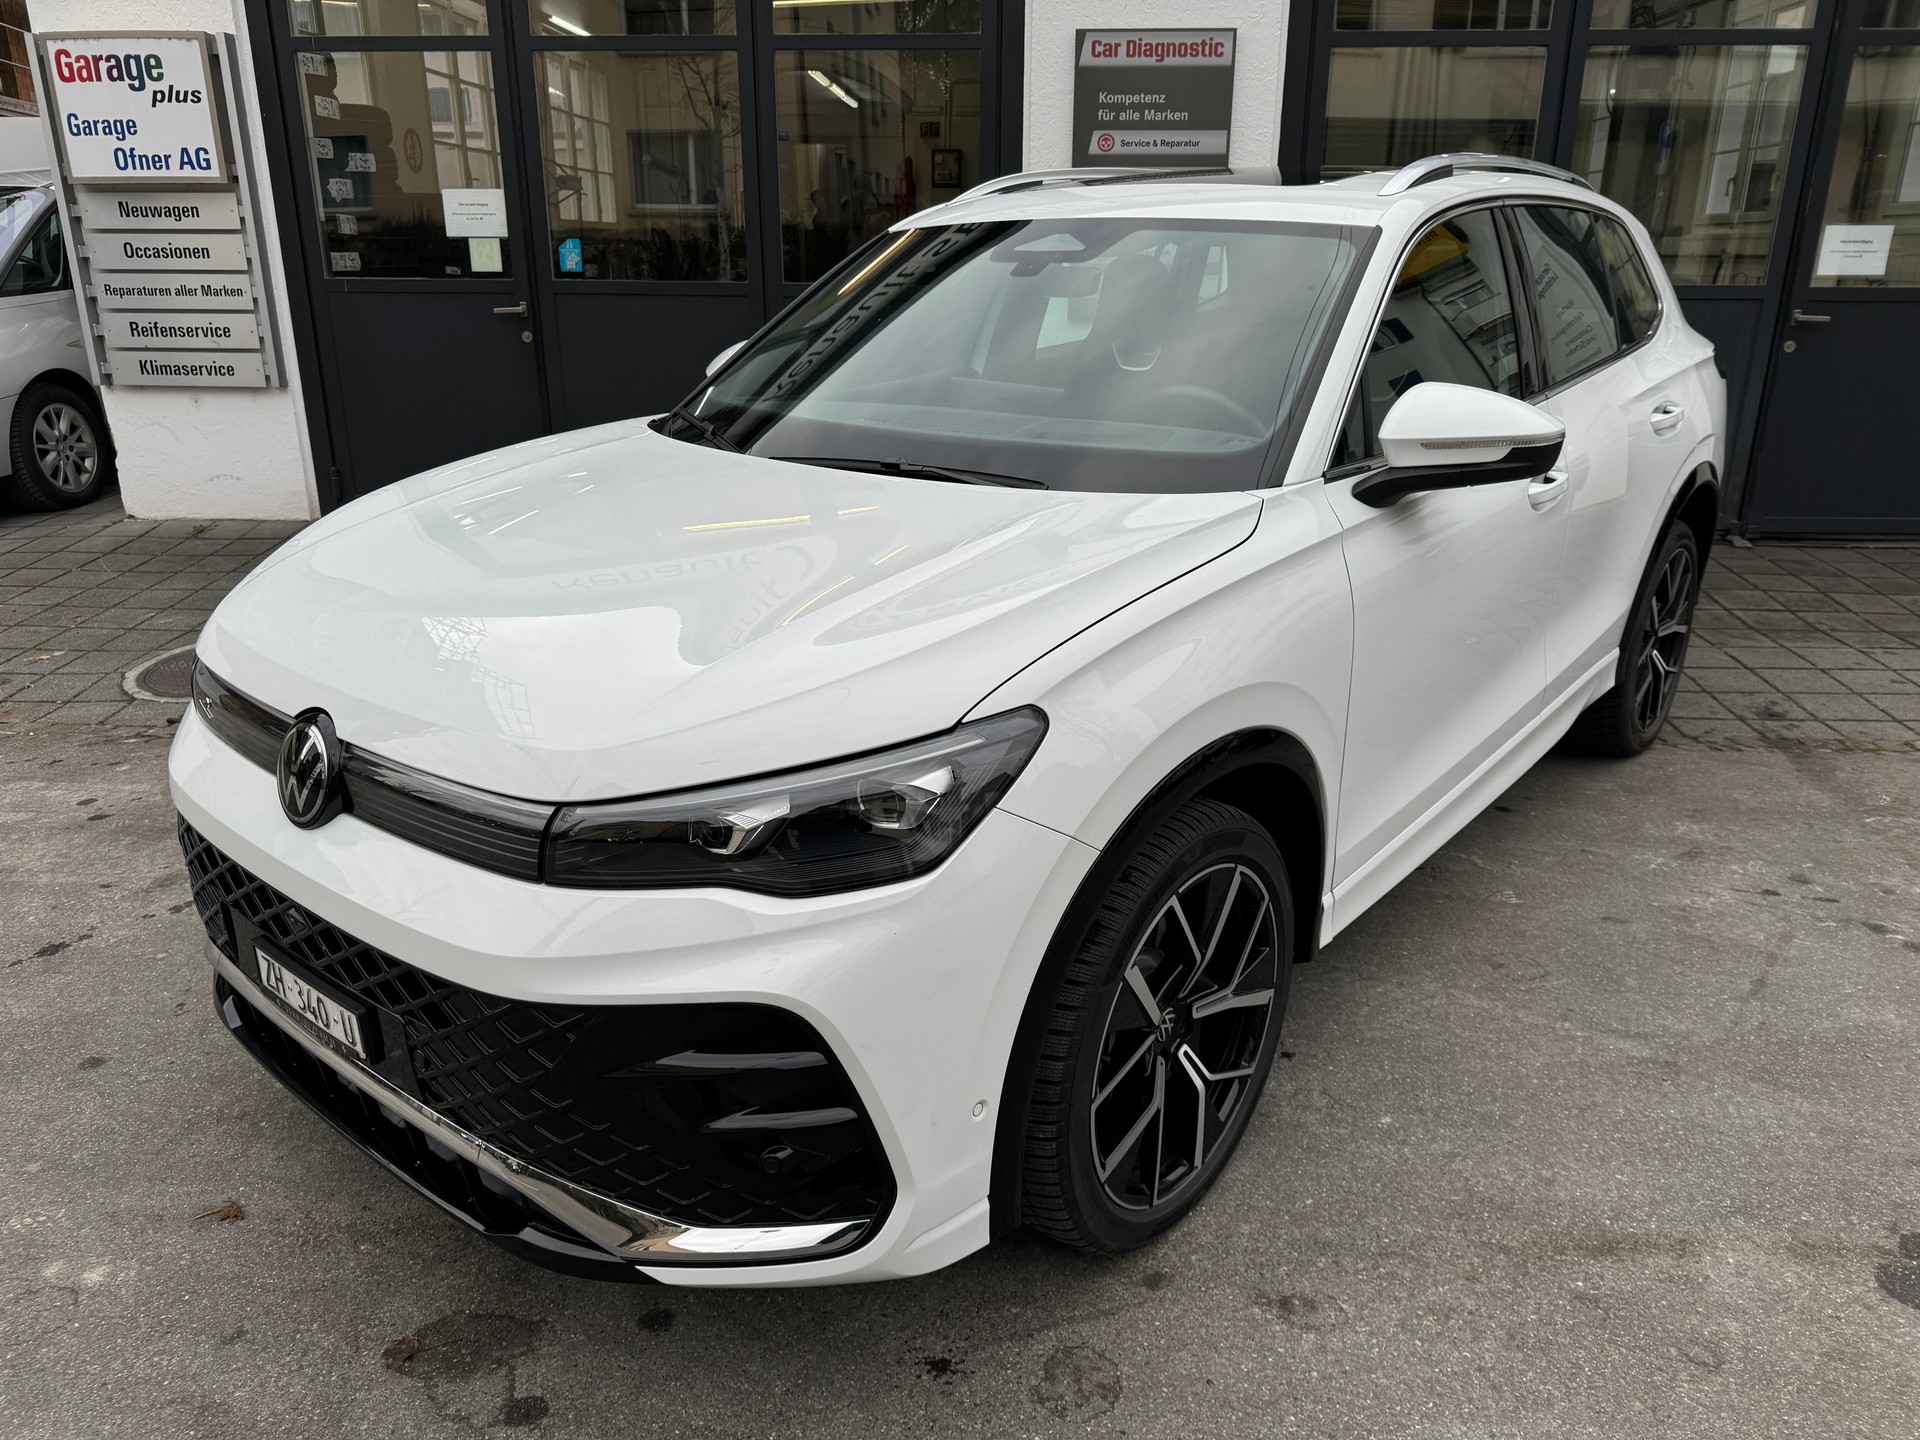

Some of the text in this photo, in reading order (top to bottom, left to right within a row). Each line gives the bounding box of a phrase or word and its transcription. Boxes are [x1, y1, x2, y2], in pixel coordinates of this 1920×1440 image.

[1091, 37, 1225, 63] Car Diagnostic
[54, 48, 164, 92] Garage
[151, 85, 202, 108] plus
[1098, 92, 1166, 106] Kompetenz
[1098, 109, 1189, 121] für alle Marken
[66, 113, 138, 141] Garage
[1120, 139, 1201, 149] Service & Reparatur
[114, 147, 212, 172] Ofner AG
[118, 201, 200, 221] Neuwagen
[123, 242, 210, 260] Occasionen
[104, 283, 243, 298] Reparaturen aller Marken
[130, 321, 231, 339] Reifenservice
[139, 360, 235, 377] Klimaservice
